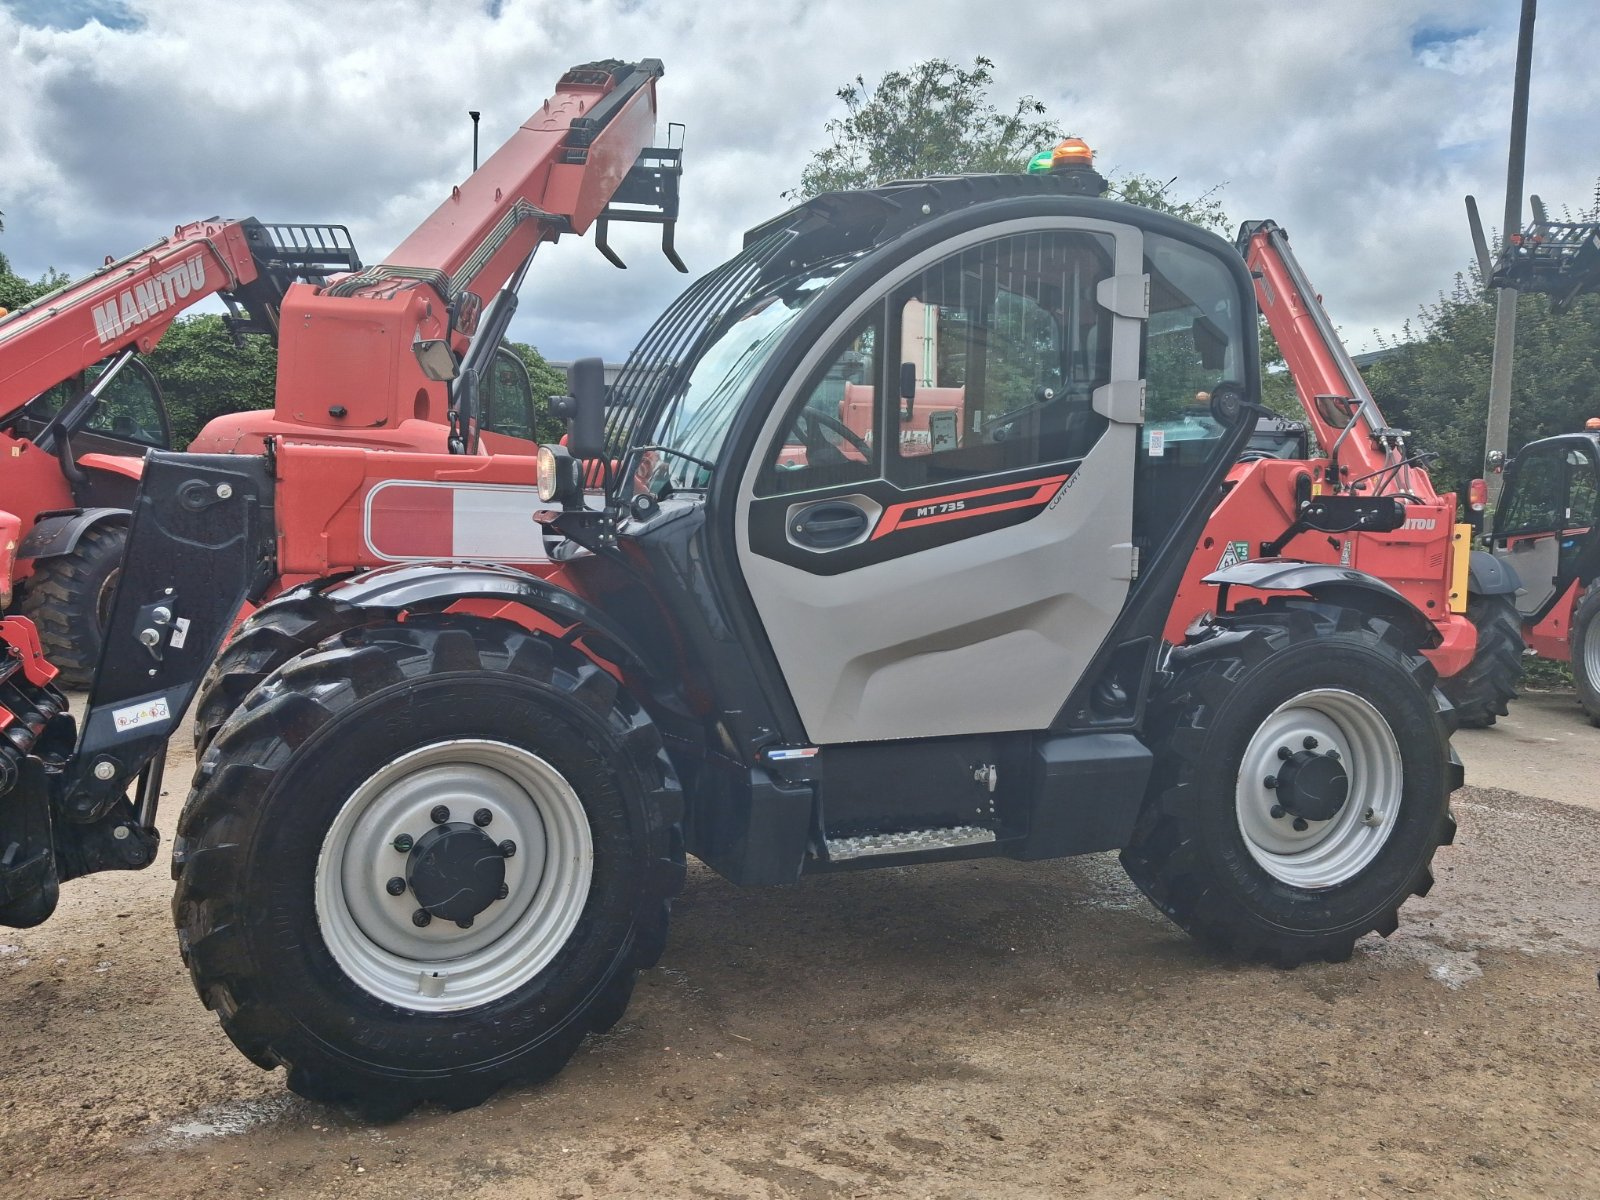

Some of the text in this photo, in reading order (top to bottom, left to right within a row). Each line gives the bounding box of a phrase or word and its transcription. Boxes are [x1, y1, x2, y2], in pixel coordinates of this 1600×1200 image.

[92, 254, 206, 344] MANITOU
[917, 501, 965, 517] MT 735
[1049, 469, 1081, 510] COMFORT
